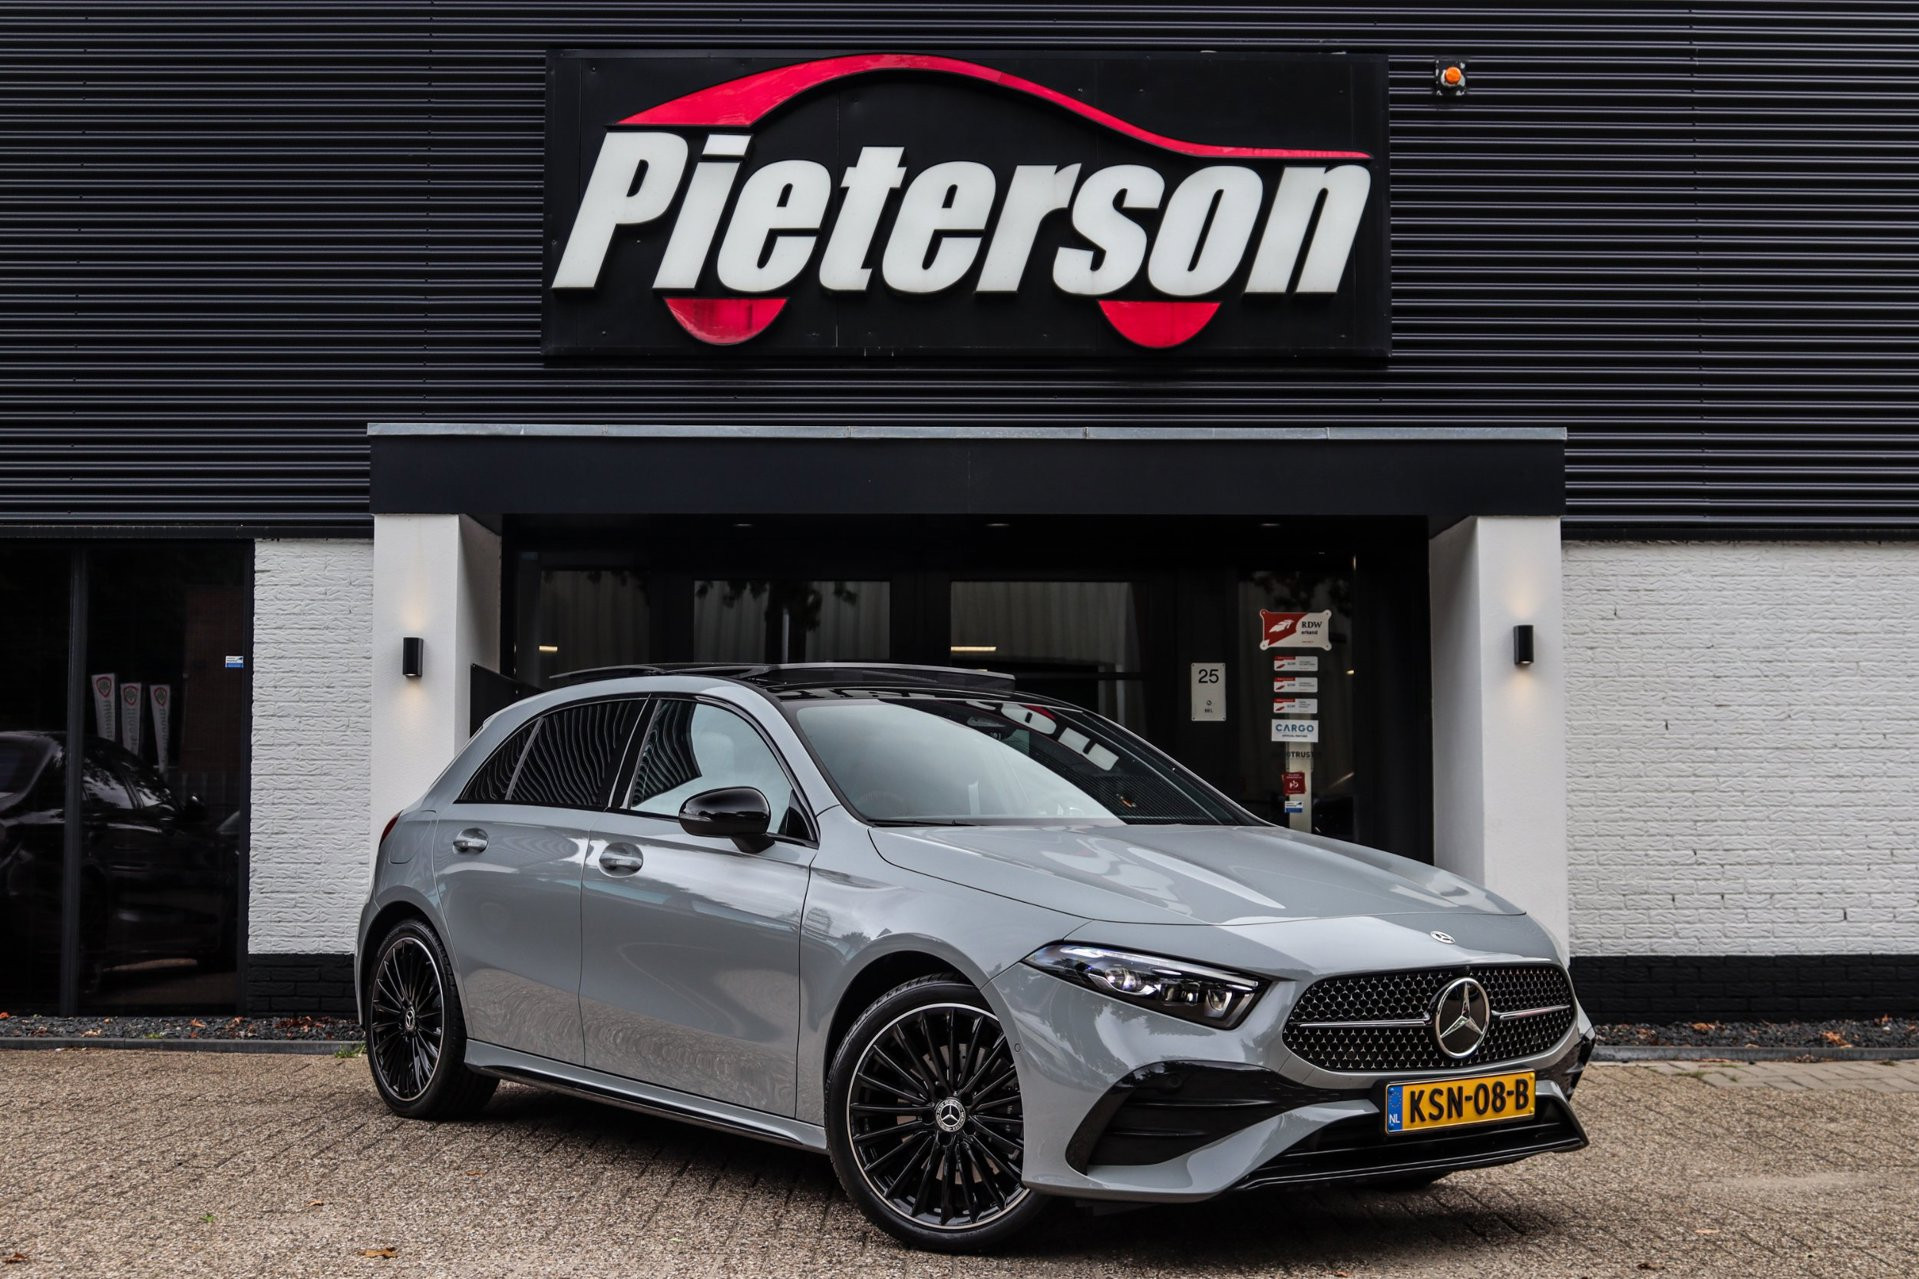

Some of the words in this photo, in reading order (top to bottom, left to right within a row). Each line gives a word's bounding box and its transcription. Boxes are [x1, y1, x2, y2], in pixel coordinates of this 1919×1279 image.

[551, 131, 1373, 297] Pieterson
[1301, 621, 1322, 629] RDW
[1198, 668, 1219, 684] 25
[1275, 723, 1314, 732] CARGO
[1409, 1078, 1529, 1123] KSN-08-B
[1388, 1113, 1401, 1124] NL
